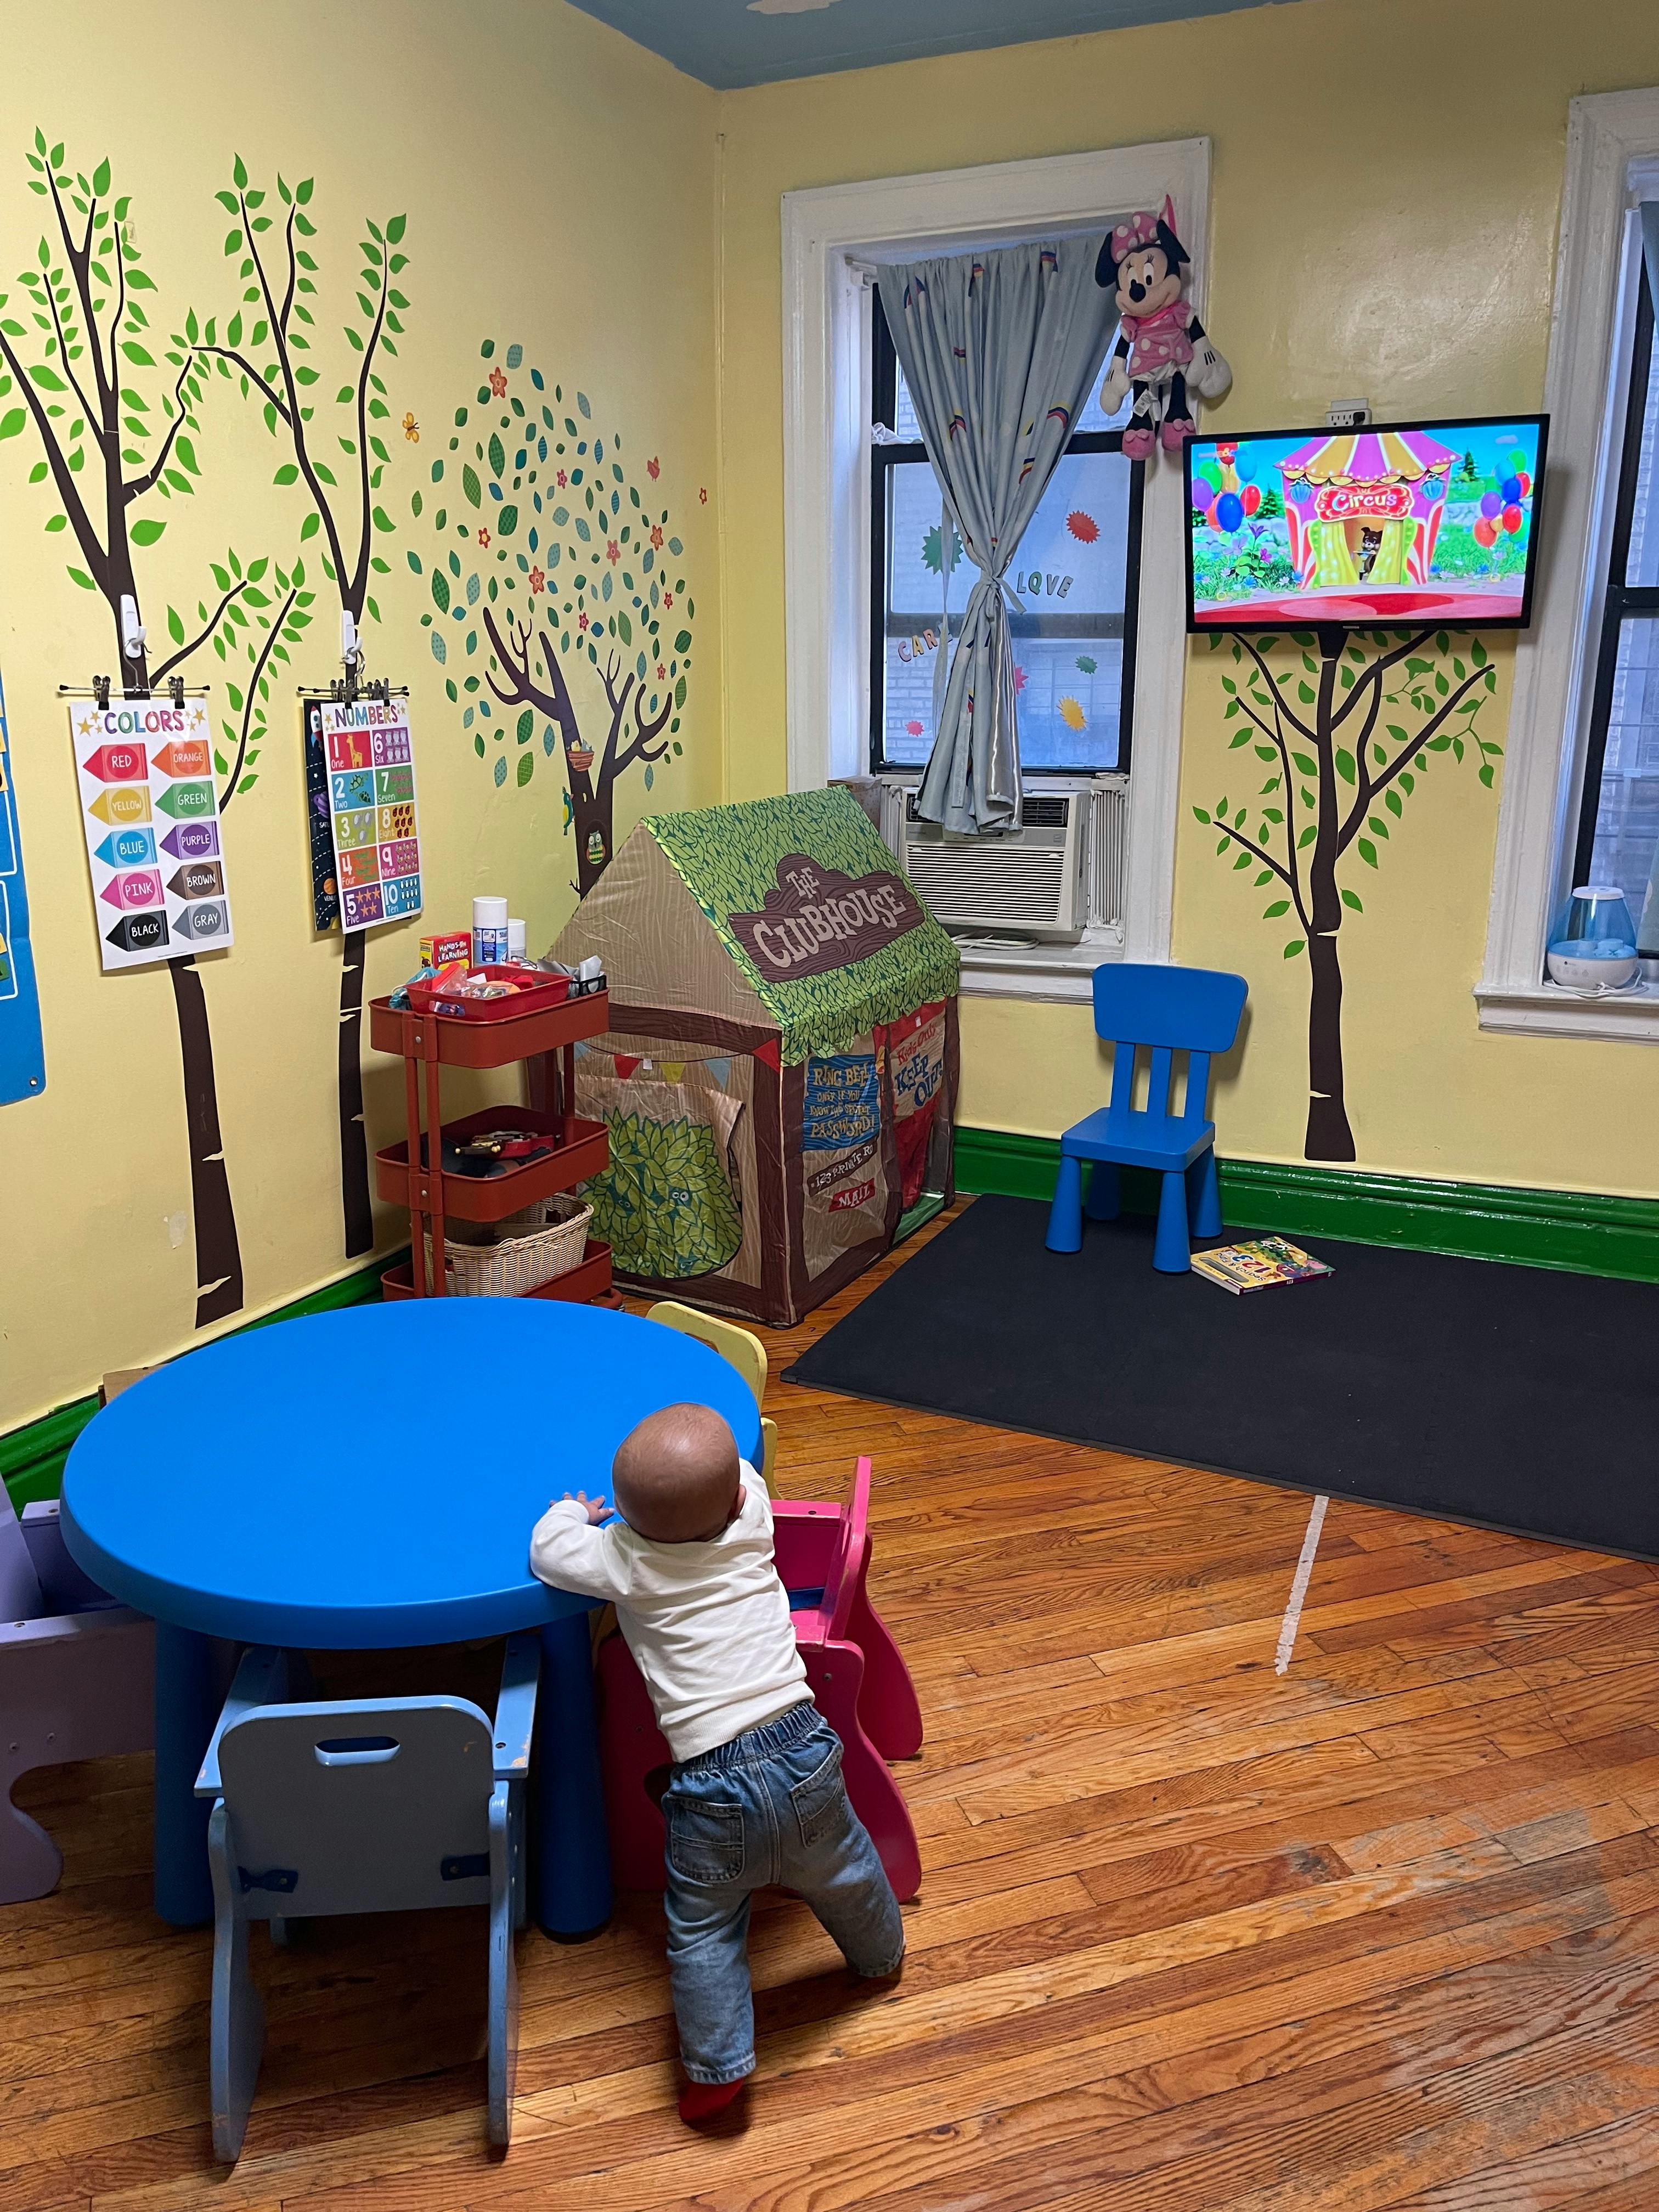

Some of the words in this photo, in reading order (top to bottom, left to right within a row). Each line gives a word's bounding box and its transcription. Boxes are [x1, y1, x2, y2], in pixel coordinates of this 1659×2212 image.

[1331, 493, 1397, 512] Circus
[104, 710, 185, 734] COLORS
[335, 704, 398, 727] NUMBERS
[333, 736, 339, 758] 1
[374, 732, 383, 754] 6
[111, 755, 132, 768] RED
[173, 752, 204, 763] ORANGE
[331, 759, 345, 769] One
[375, 754, 385, 764] Six
[335, 777, 345, 799] 2
[381, 772, 390, 792] 7
[112, 799, 142, 812] YELLOW
[178, 793, 207, 806] GREEN
[334, 800, 348, 809] Two
[377, 793, 396, 804] Seven
[382, 808, 391, 829] 8
[341, 817, 350, 838] 3
[379, 827, 395, 839] Eight
[120, 840, 145, 855] BLUE
[181, 833, 210, 847] PURPLE
[337, 838, 356, 848] Three
[382, 847, 393, 866] 9
[342, 854, 352, 875] 4
[187, 873, 216, 887] BROWN
[382, 868, 396, 877] Nine
[342, 877, 356, 886] Four
[786, 867, 820, 899] THE
[125, 882, 154, 897] PINK
[384, 884, 398, 905] 10
[346, 894, 357, 915] 5
[387, 905, 399, 914] Ten
[194, 912, 218, 927] GRAY
[347, 915, 360, 925] Five
[753, 884, 907, 968] CLUBHOUSE
[131, 923, 159, 937] BLACK
[438, 949, 468, 963] LEARNING
[813, 1065, 842, 1087] RING
[845, 1062, 870, 1087] BELL
[895, 1053, 928, 1096] KEEP
[811, 1114, 874, 1139] PASSWORD!
[815, 1172, 832, 1187] 123
[832, 1153, 862, 1177] PRIVATE
[838, 1184, 870, 1207] MAIL
